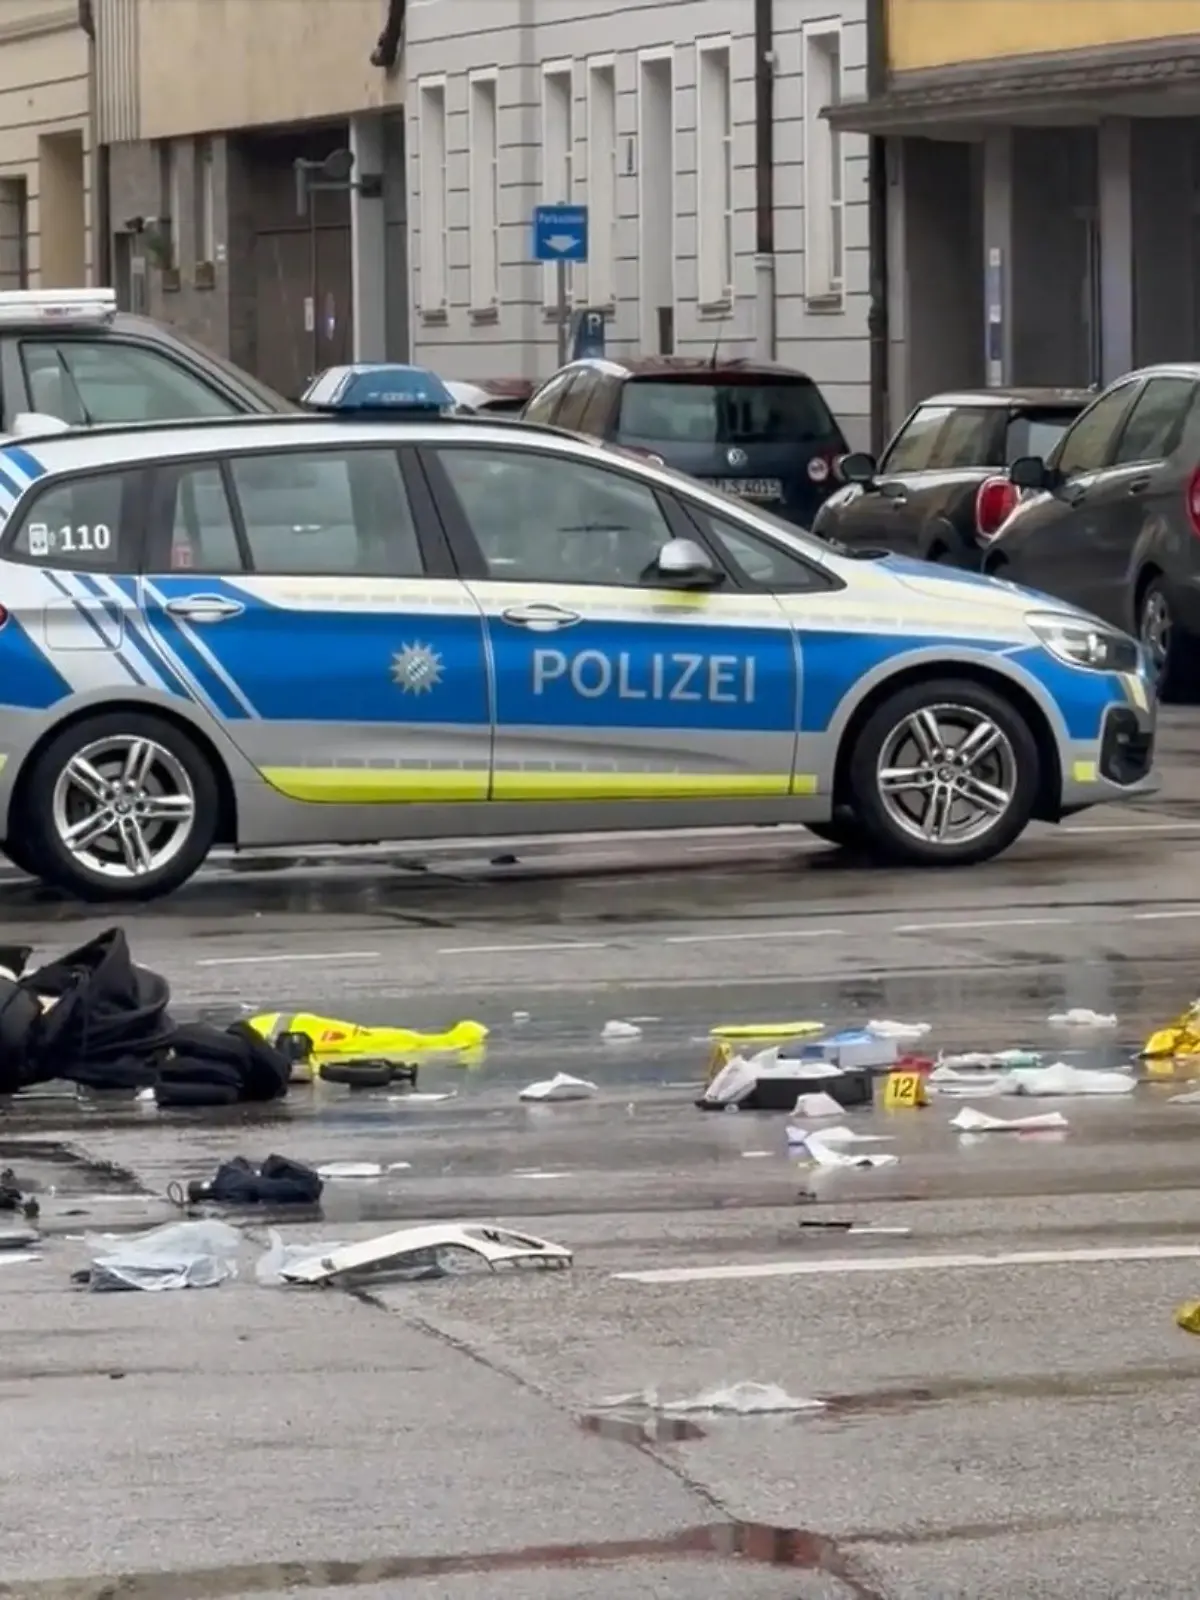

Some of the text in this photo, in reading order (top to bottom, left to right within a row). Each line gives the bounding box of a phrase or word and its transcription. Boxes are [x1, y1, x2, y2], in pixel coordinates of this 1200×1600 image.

[587, 312, 601, 335] P
[60, 524, 111, 551] 110
[533, 648, 756, 703] POLIZEI
[893, 1077, 914, 1098] 12
